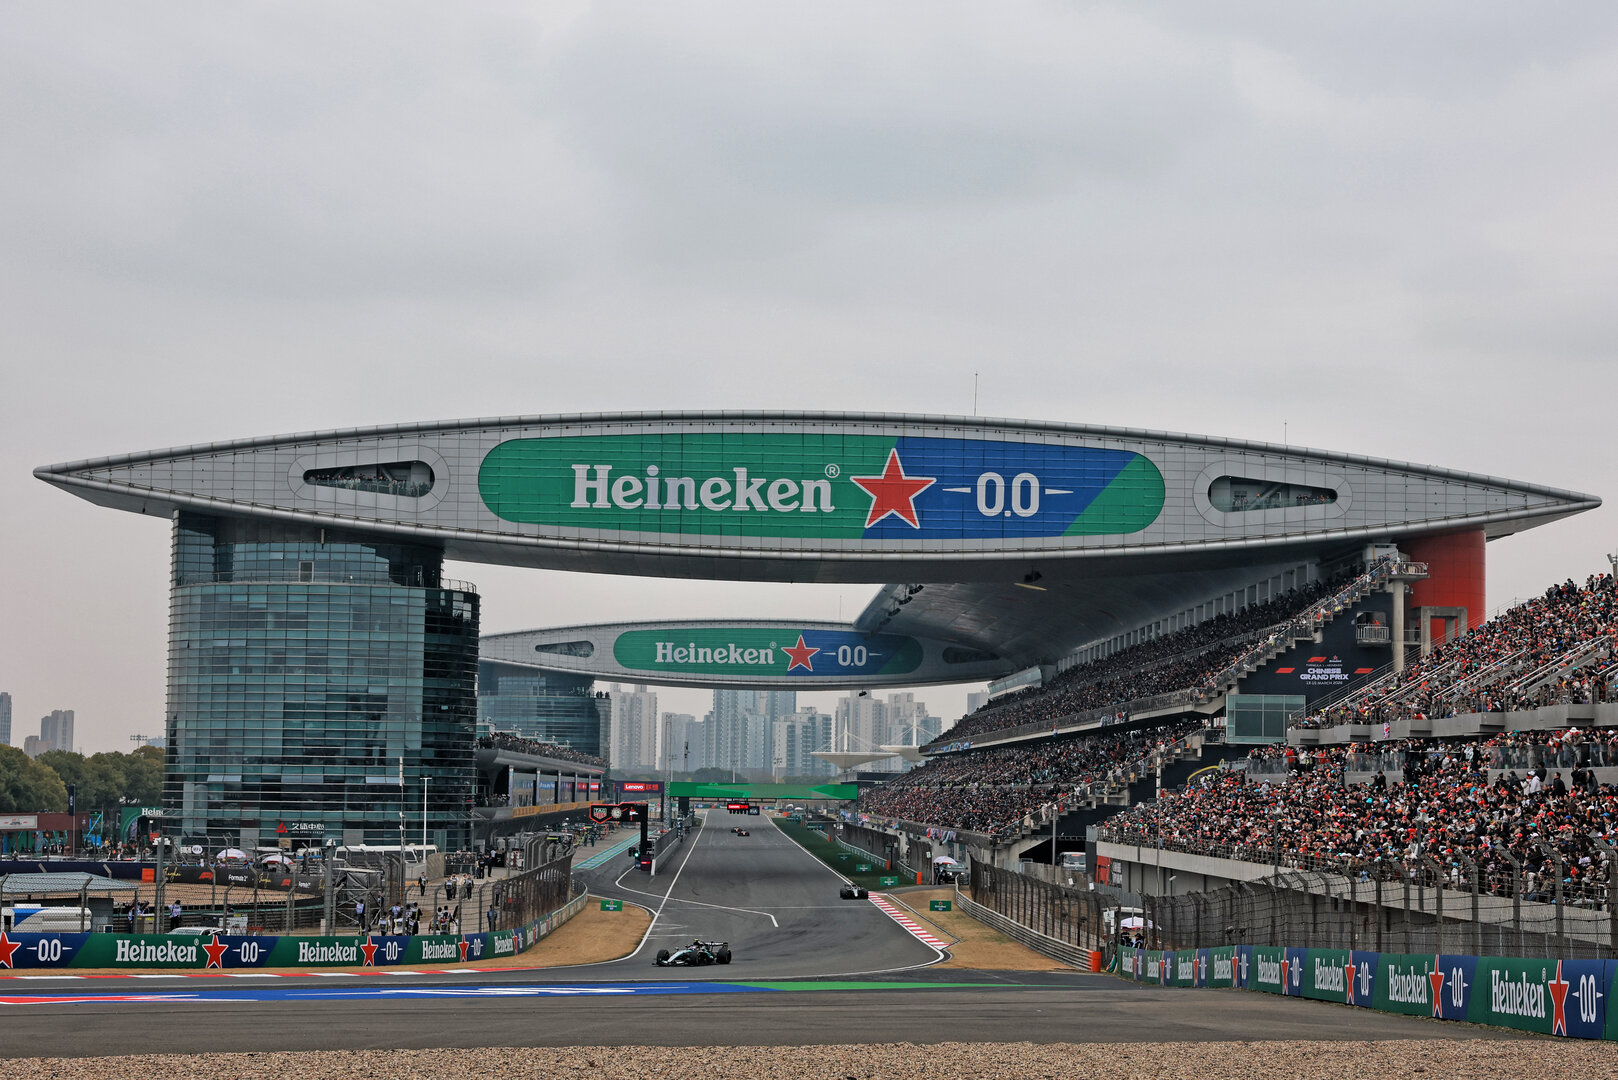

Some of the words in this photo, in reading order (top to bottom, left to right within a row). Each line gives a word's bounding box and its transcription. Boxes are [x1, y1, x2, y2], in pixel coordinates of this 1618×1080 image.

[976, 471, 1040, 518] 0.0
[838, 645, 867, 667] 0.0
[37, 938, 62, 962] 0.0
[240, 941, 259, 963] 0.0
[385, 941, 398, 962] 0.0
[1451, 967, 1464, 1008] 0.0
[1578, 974, 1597, 1023] 0.0
